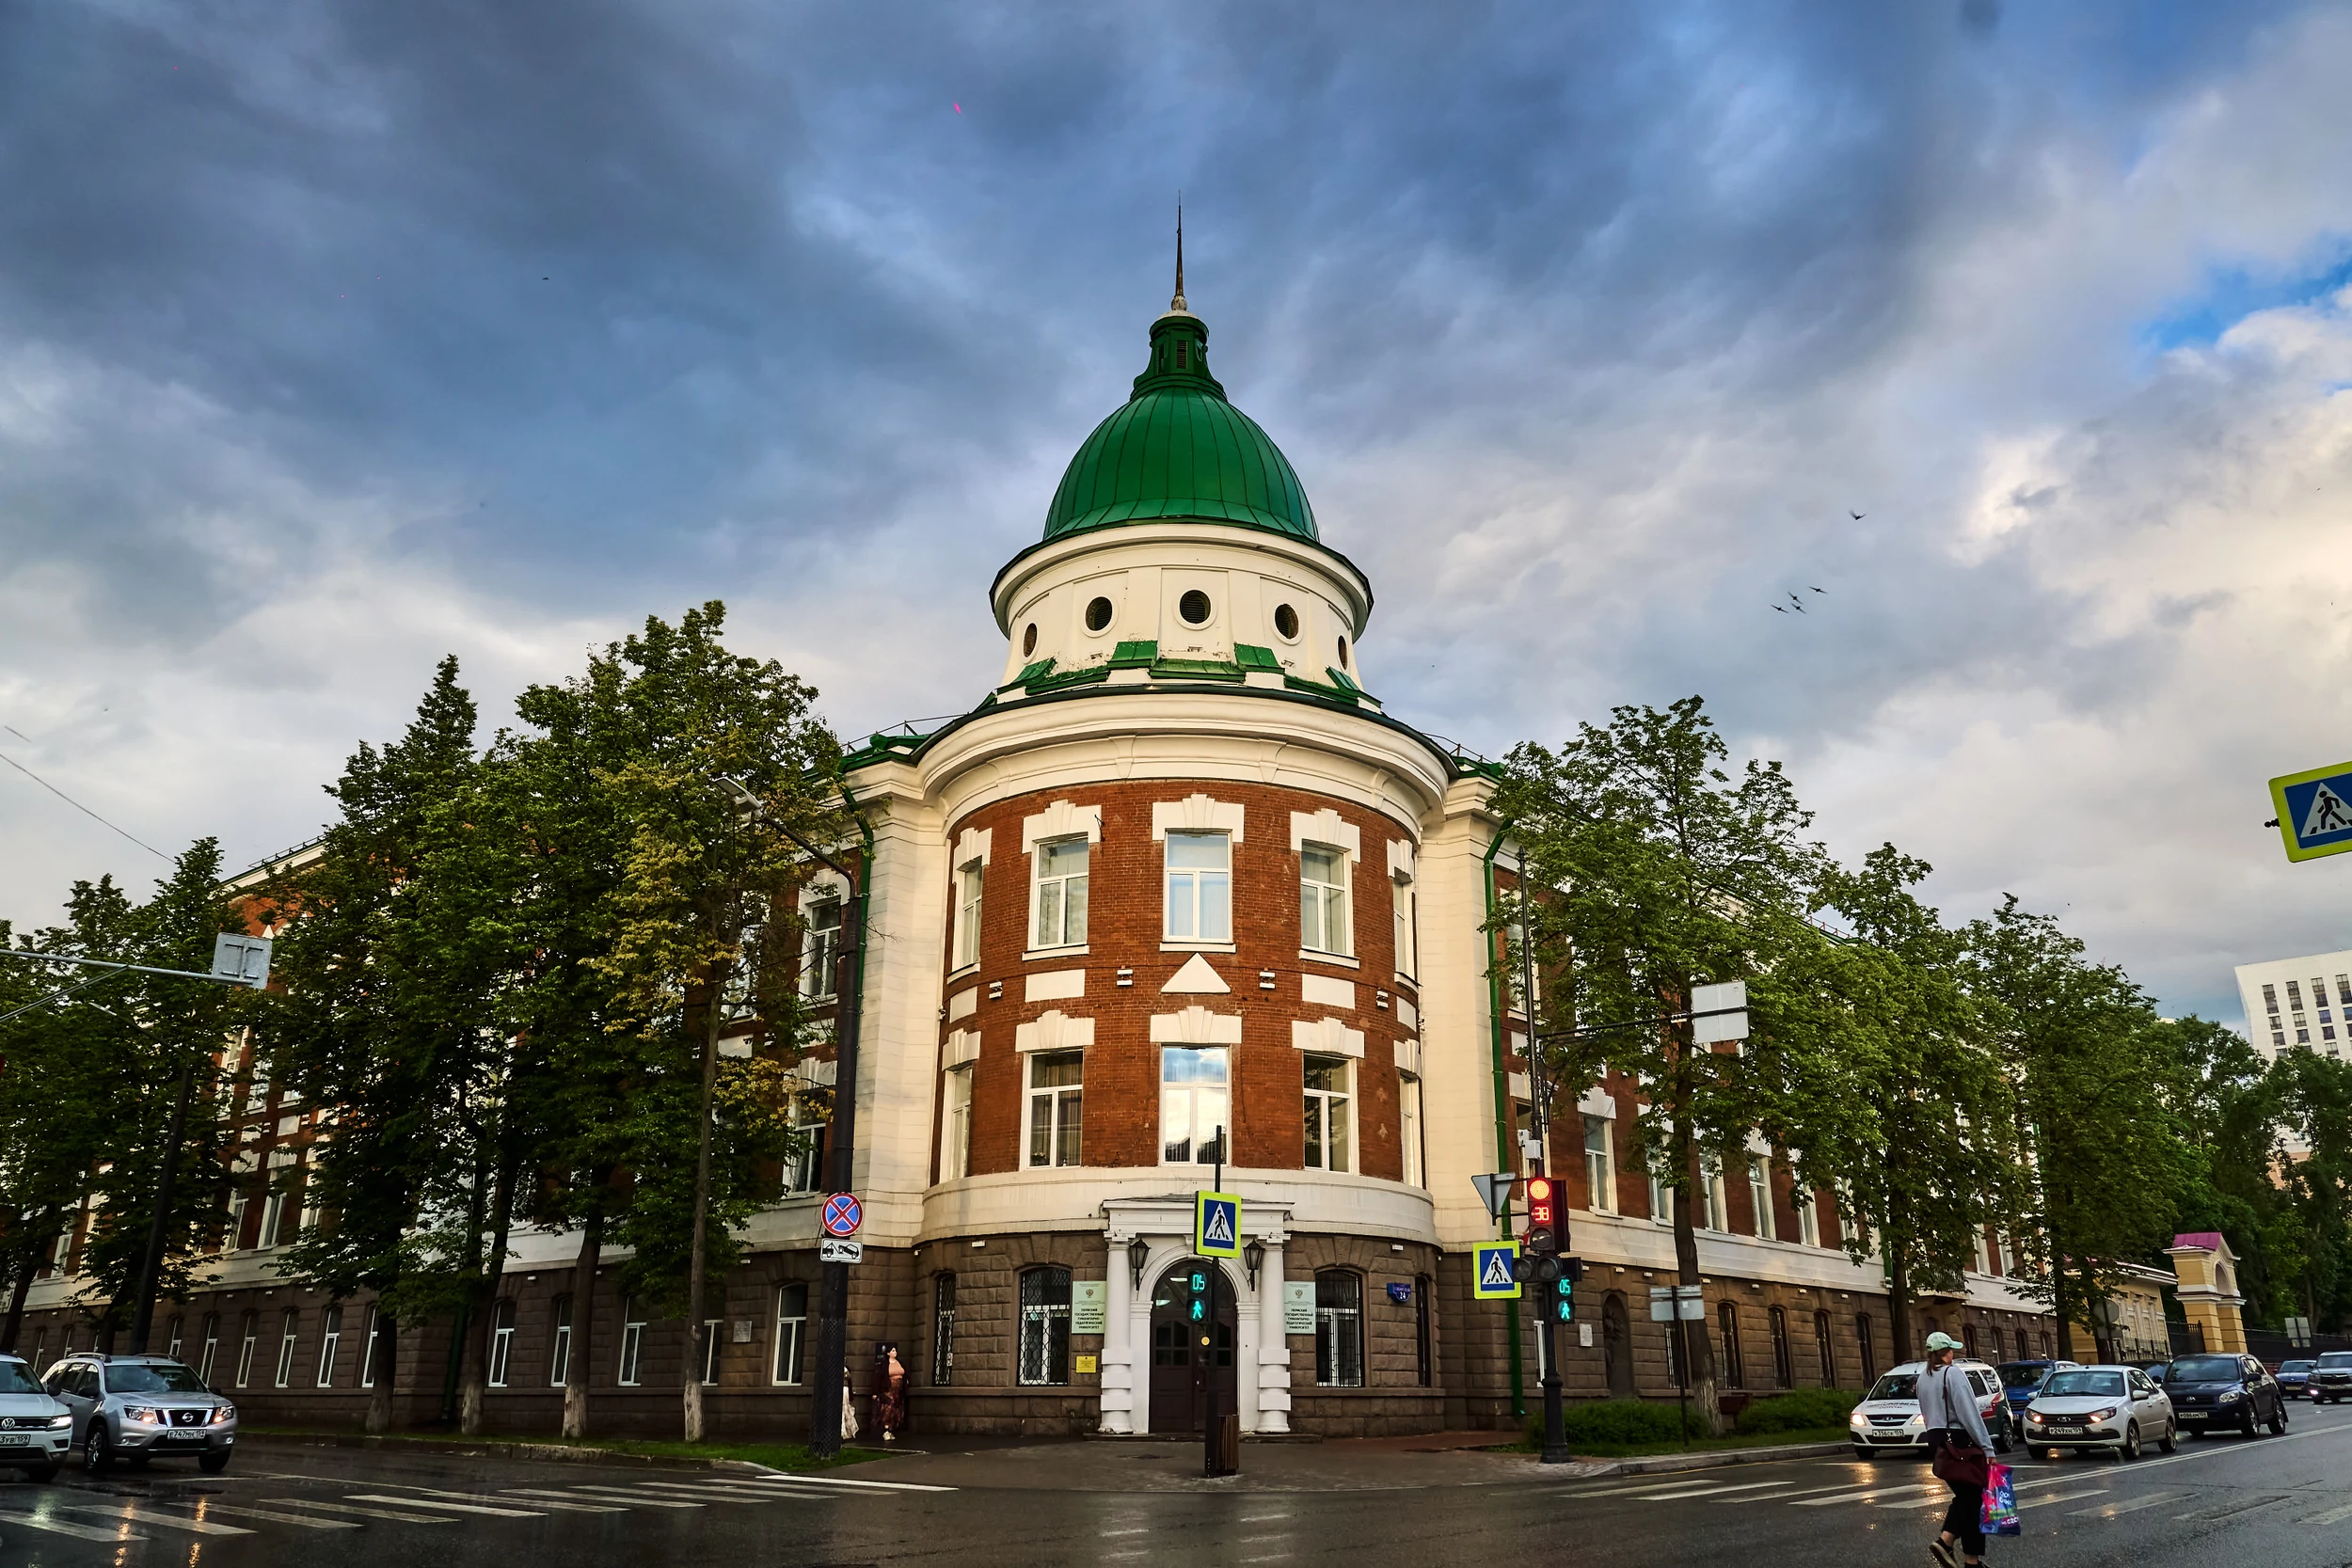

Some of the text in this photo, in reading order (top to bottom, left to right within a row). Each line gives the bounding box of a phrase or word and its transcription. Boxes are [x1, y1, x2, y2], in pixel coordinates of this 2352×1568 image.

[1534, 1207, 1549, 1221] 38
[1192, 1274, 1205, 1290] 05
[1559, 1279, 1571, 1293] 05
